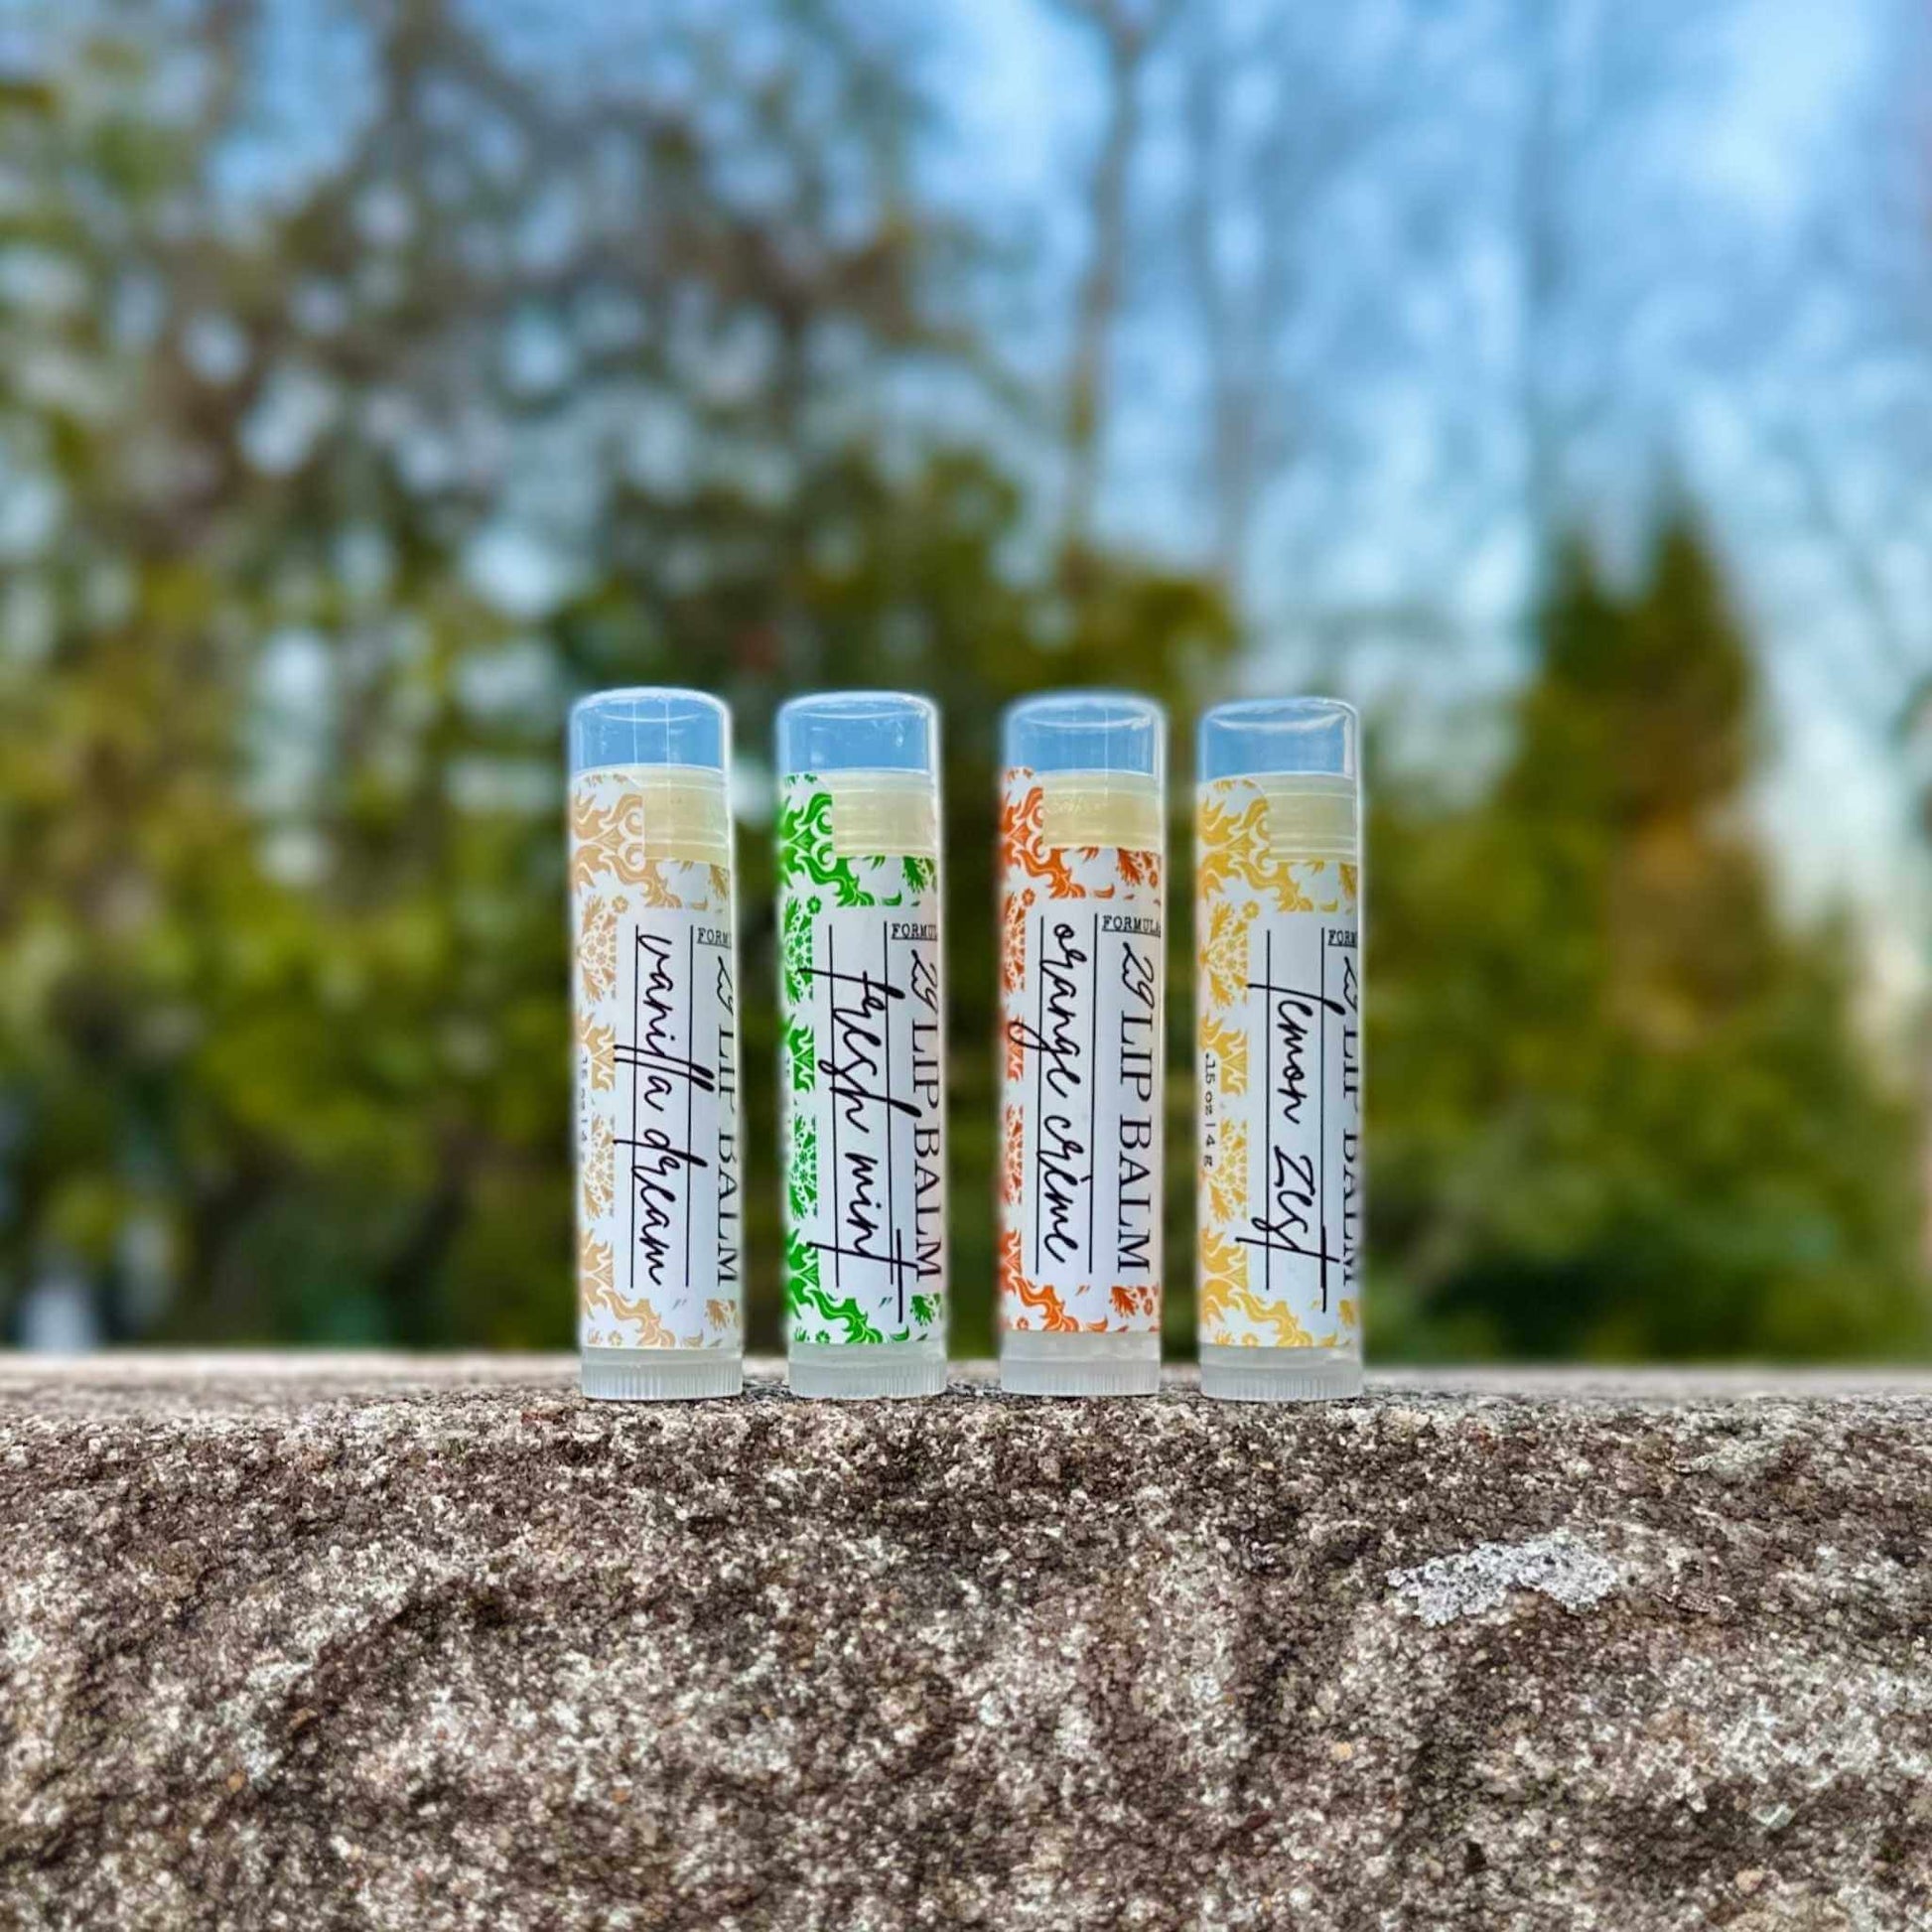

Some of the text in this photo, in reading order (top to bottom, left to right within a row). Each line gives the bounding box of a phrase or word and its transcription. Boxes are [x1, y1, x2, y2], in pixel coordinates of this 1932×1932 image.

[912, 1019, 938, 1109] LIP
[1009, 923, 1087, 1098] orange
[1246, 983, 1346, 1125] lemon
[613, 934, 715, 1286] vanilla dream
[796, 967, 921, 1323] fresh mint
[1118, 941, 1155, 1274] 29 LIP BALM
[913, 1122, 941, 1283] BALM
